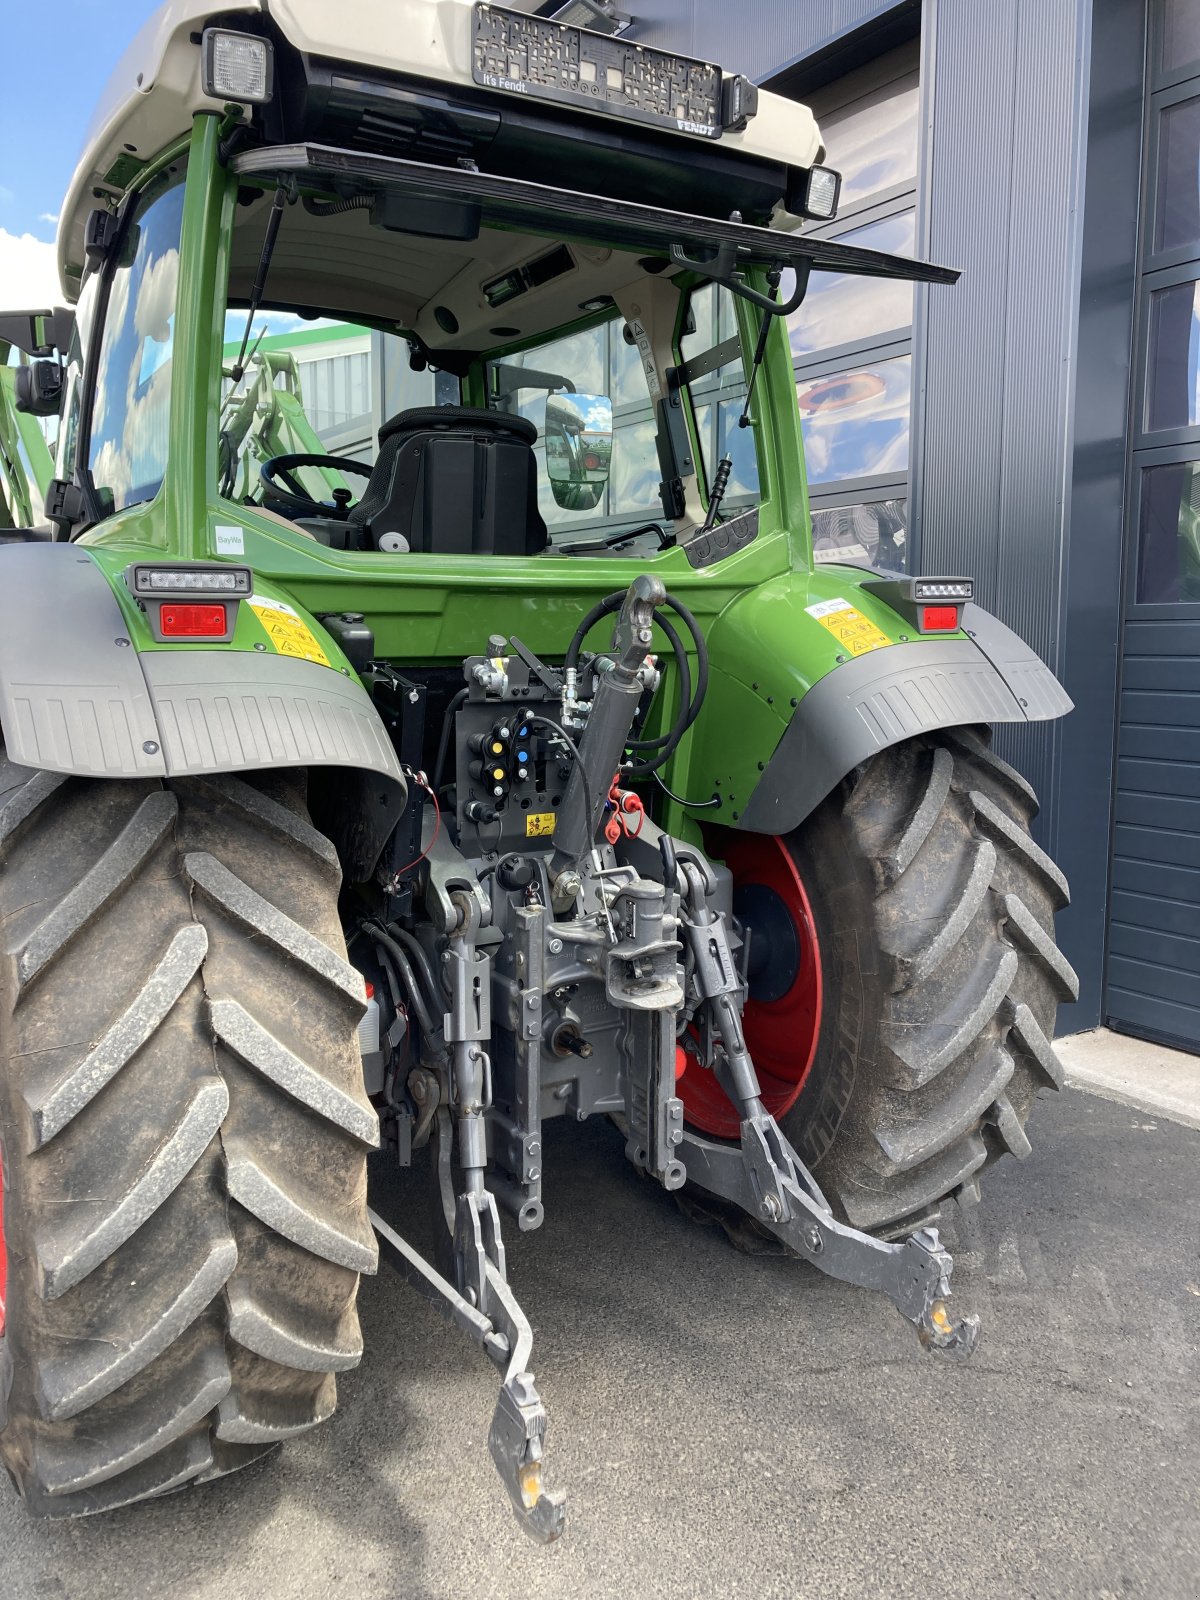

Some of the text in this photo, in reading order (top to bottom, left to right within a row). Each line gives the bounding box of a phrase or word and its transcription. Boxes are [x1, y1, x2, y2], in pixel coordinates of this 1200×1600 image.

[483, 73, 528, 94] It's Fendt.
[677, 119, 715, 136] FENDT
[217, 536, 242, 544] BayWa
